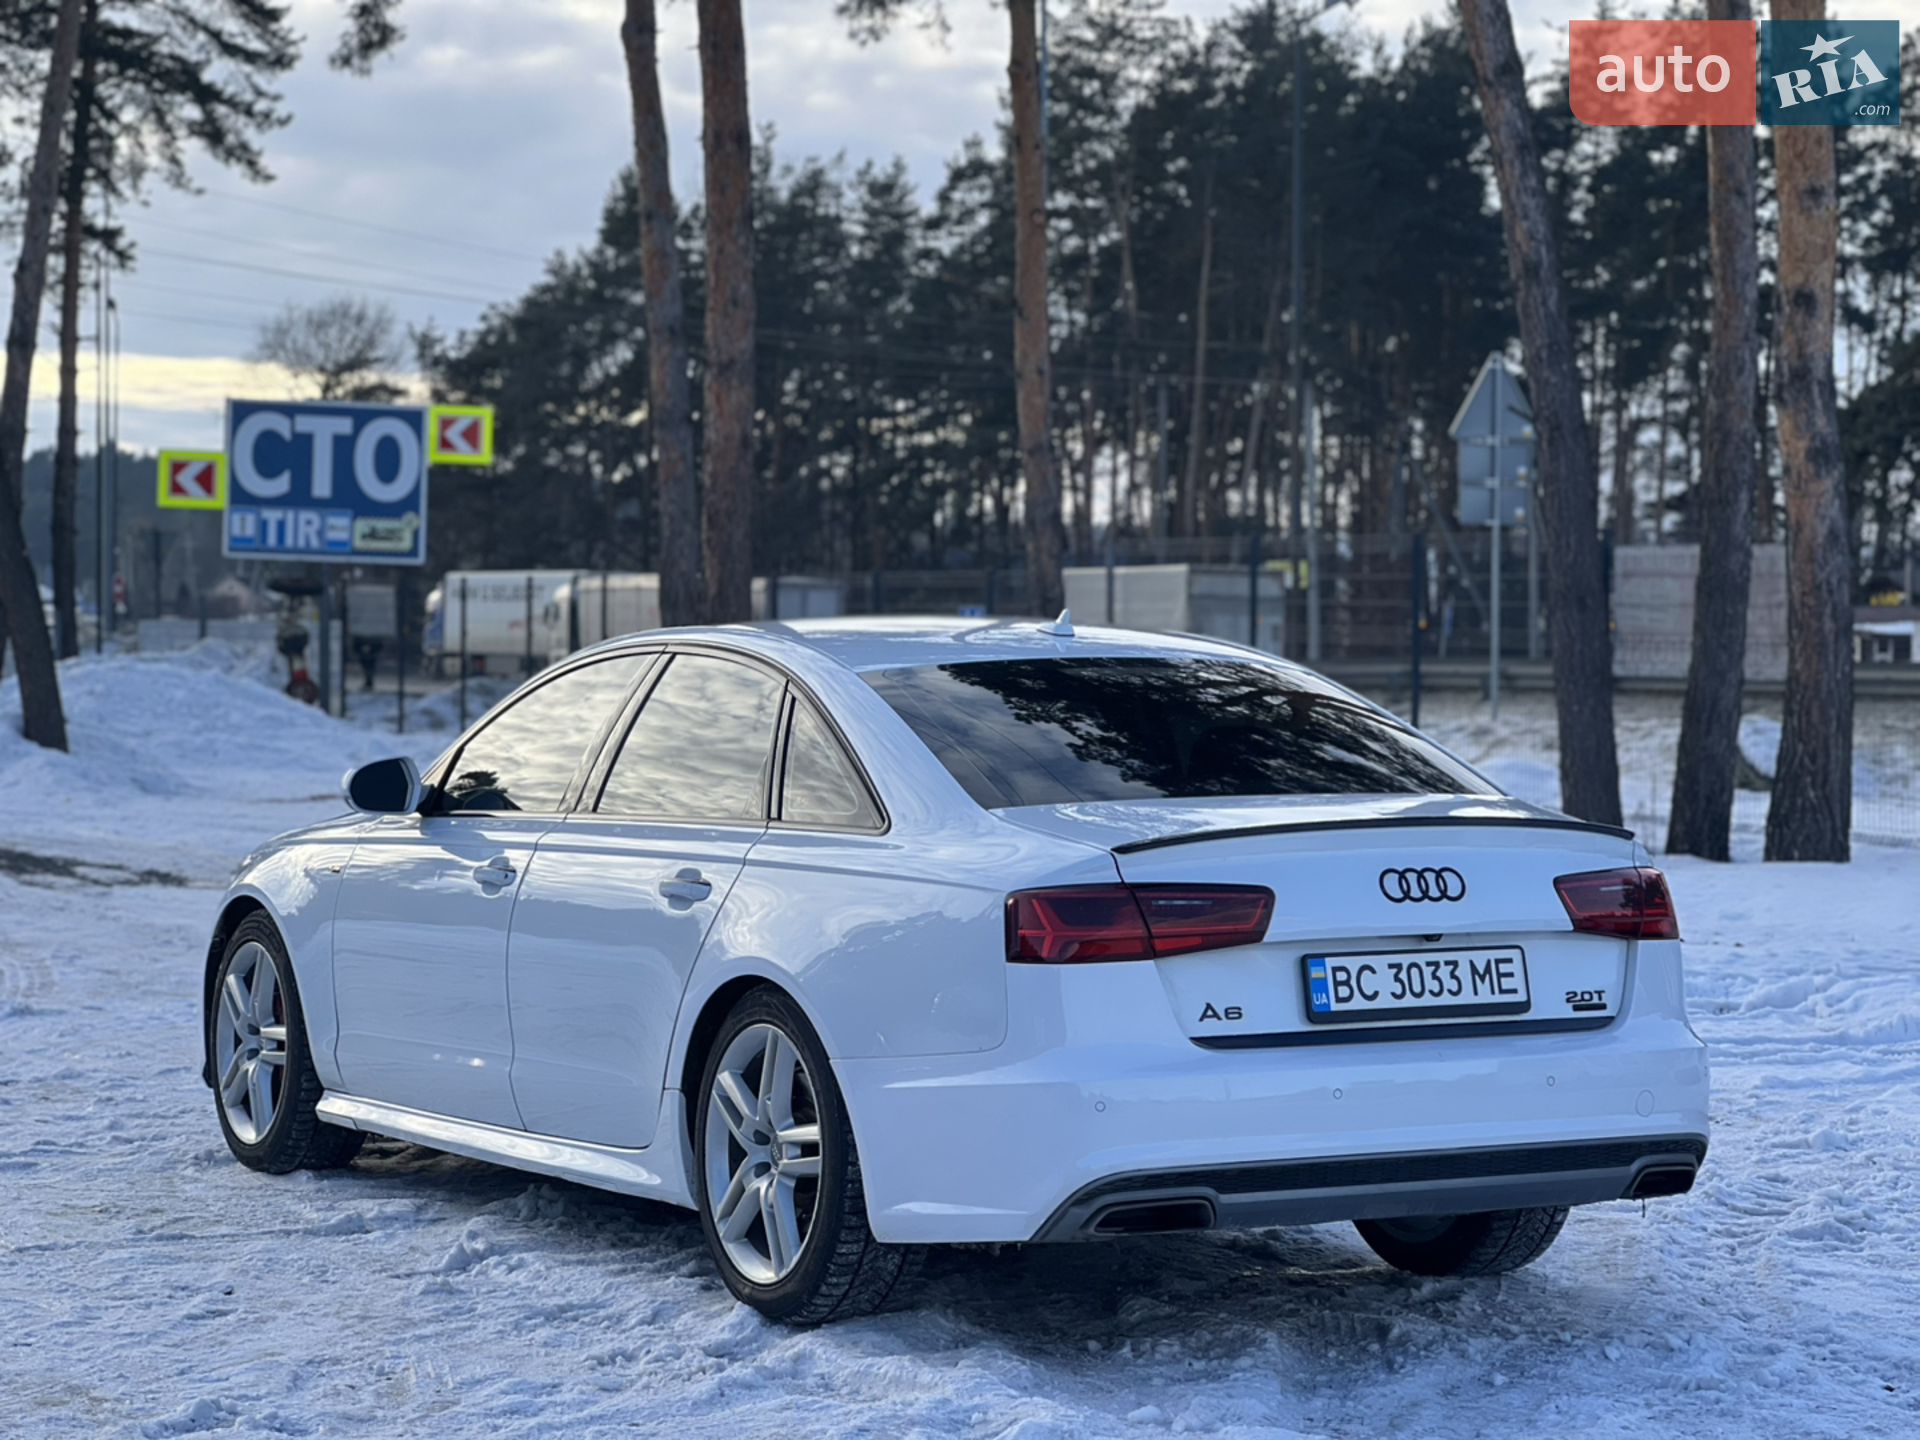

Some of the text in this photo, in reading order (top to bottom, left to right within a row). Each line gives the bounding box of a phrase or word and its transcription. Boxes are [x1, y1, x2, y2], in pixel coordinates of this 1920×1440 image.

[232, 411, 421, 503] СТО
[260, 509, 322, 549] TIR
[1313, 992, 1329, 1005] UA
[1331, 957, 1519, 1004] BC 3033 ME
[1198, 1002, 1243, 1022] A6
